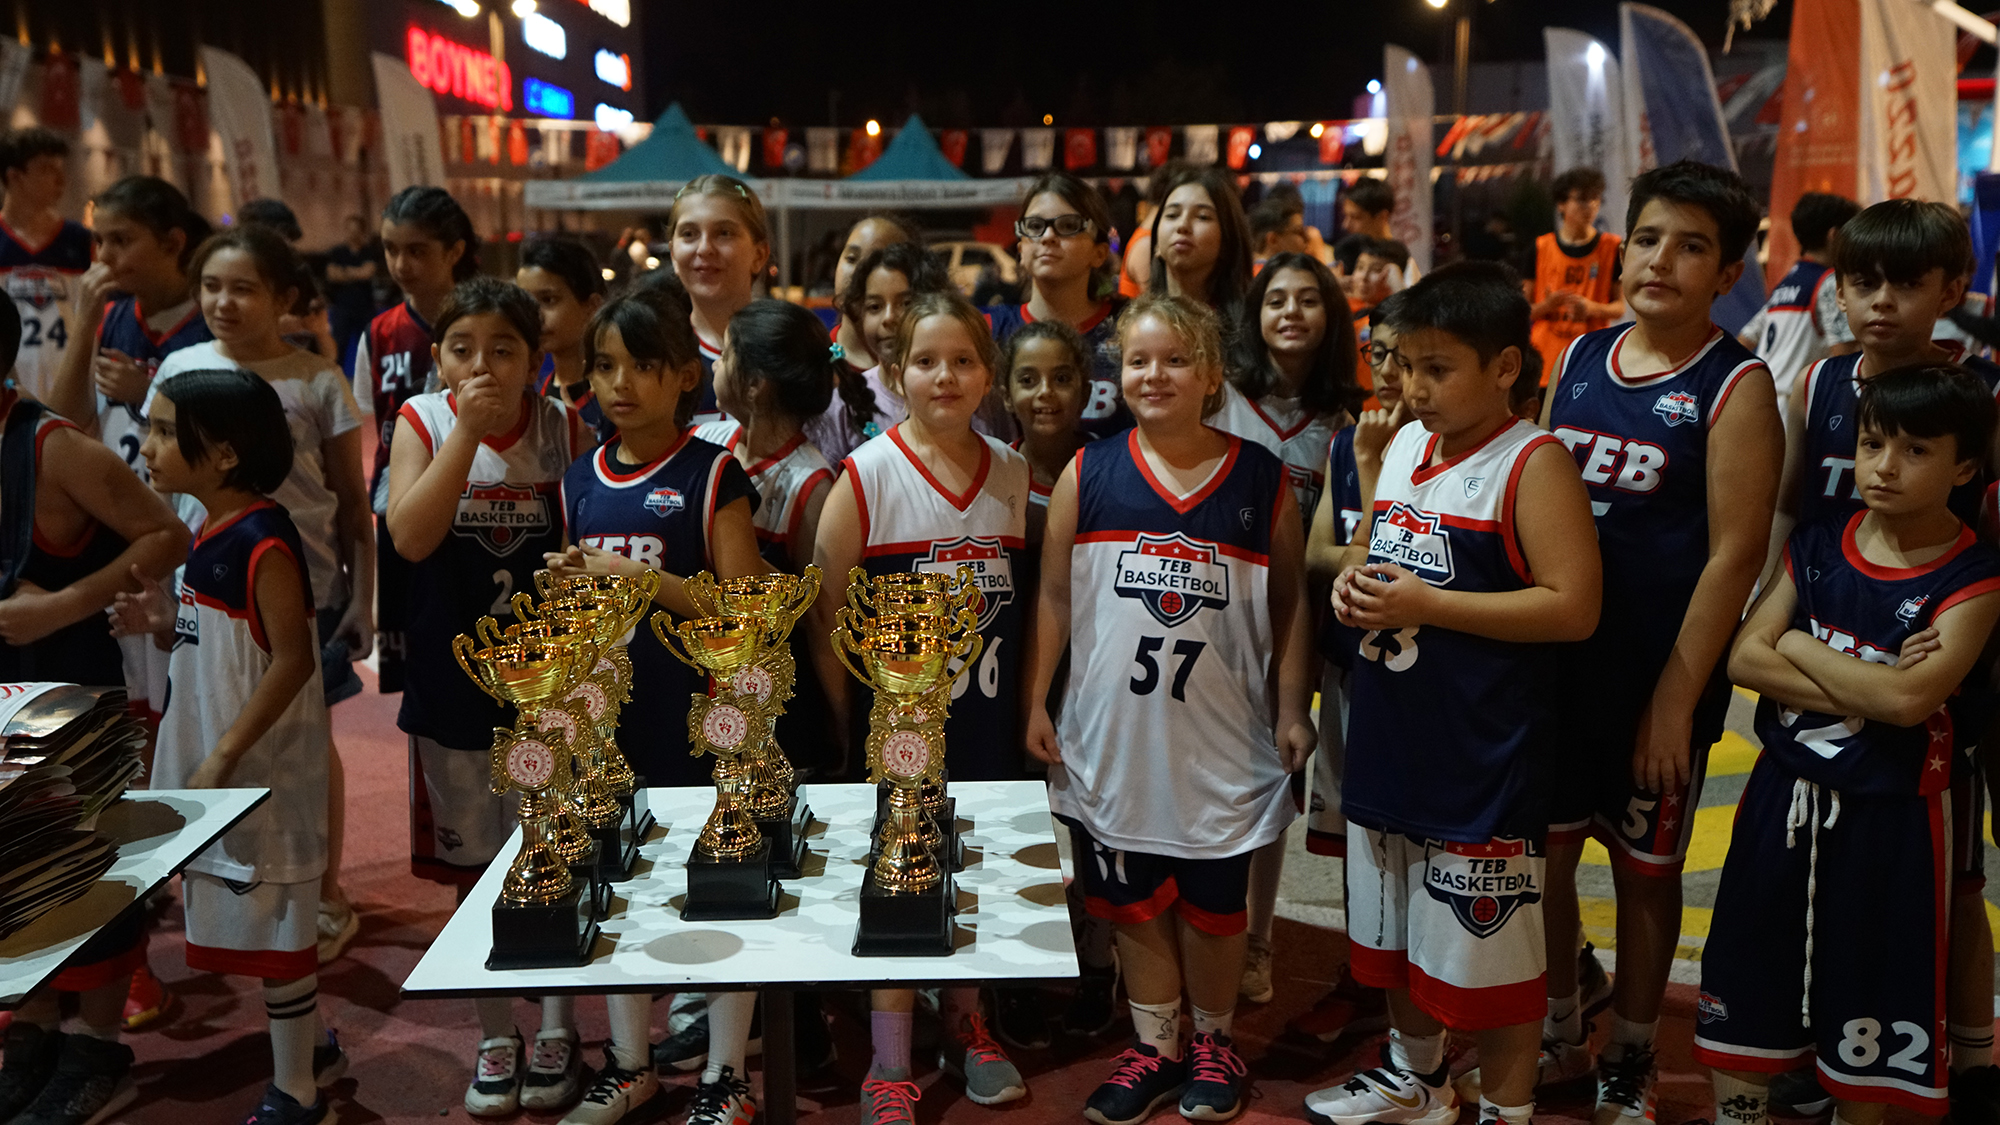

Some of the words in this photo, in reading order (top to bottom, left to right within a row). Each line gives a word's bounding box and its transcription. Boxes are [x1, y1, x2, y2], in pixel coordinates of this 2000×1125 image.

[23, 318, 67, 348] 24
[381, 350, 412, 393] 24
[460, 512, 543, 524] BASKETBOL
[489, 501, 516, 512] TEB
[1159, 558, 1192, 574] TEB
[1124, 570, 1223, 596] BASKETBOL
[1129, 634, 1208, 703] 57
[1431, 865, 1537, 892] BASKETBOL
[1468, 858, 1508, 875] TEB
[1837, 1017, 1930, 1076] 82
